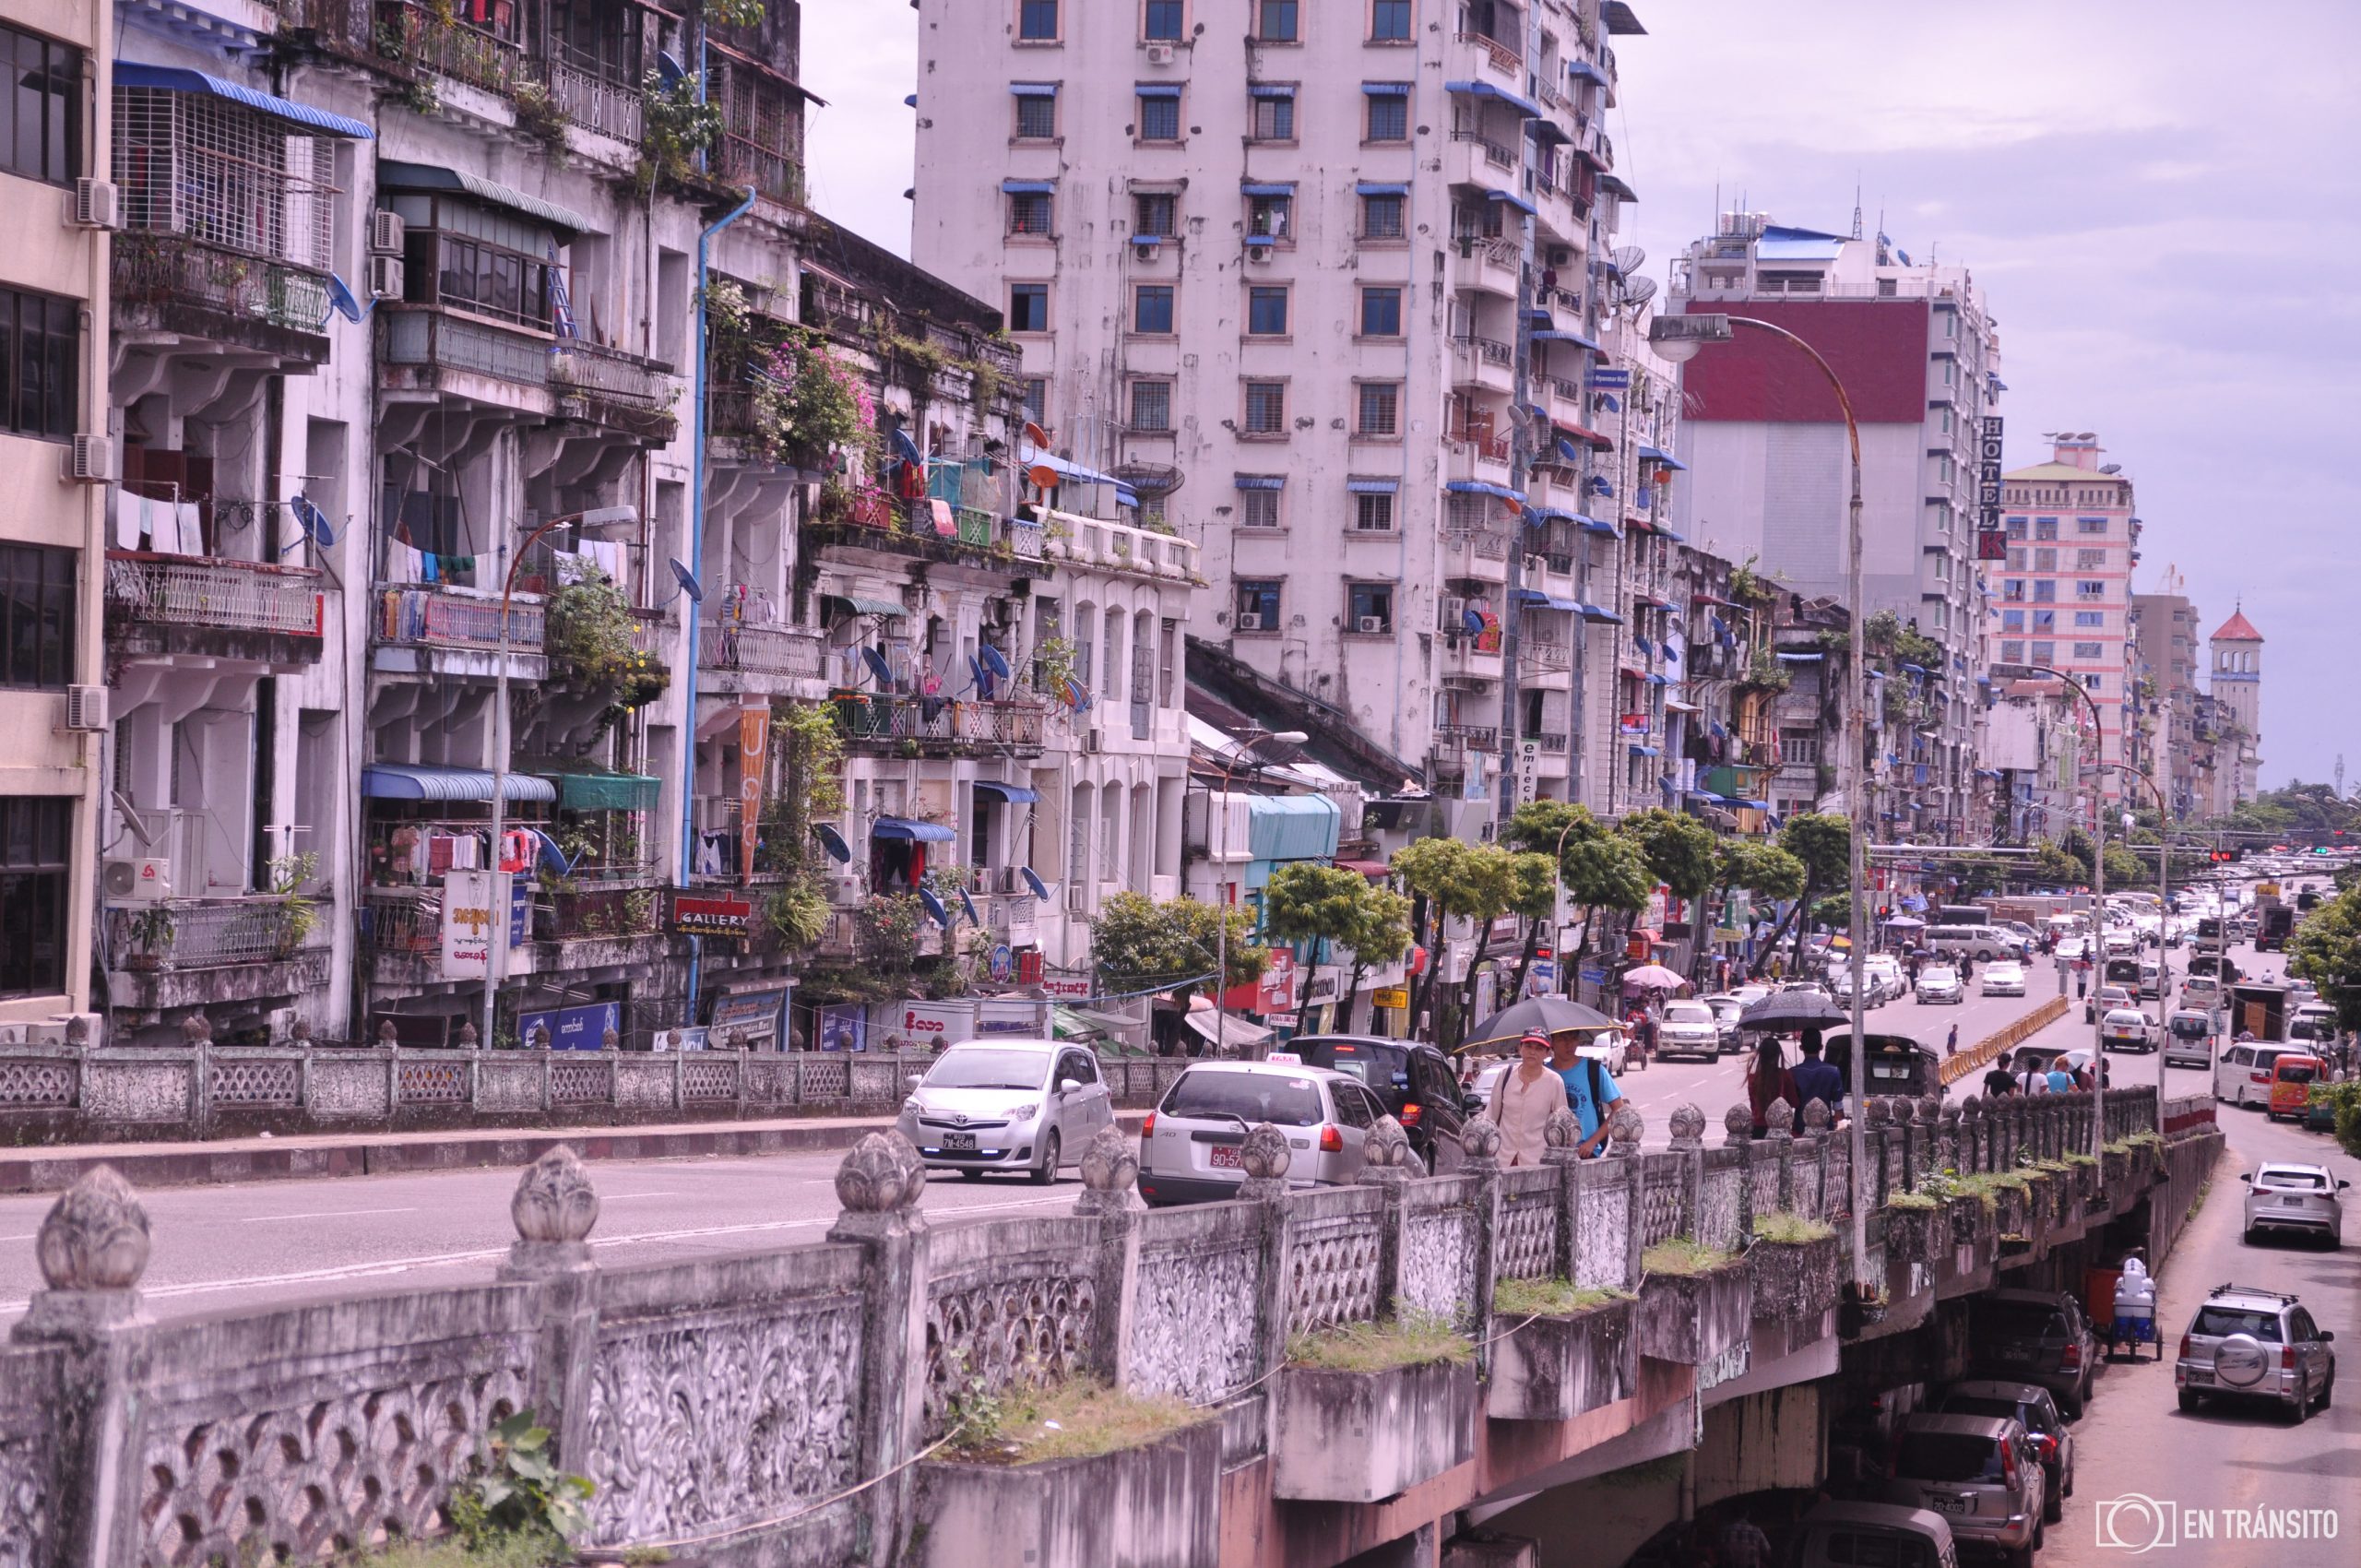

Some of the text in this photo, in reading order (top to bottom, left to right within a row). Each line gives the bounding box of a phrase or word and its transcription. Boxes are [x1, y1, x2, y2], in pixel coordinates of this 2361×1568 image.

[1982, 420, 2001, 526] HOTEL
[1979, 532, 2006, 557] K
[682, 912, 748, 926] GALLERY
[943, 1138, 974, 1149] 7M-4548
[1213, 1154, 1243, 1167] 9D-57
